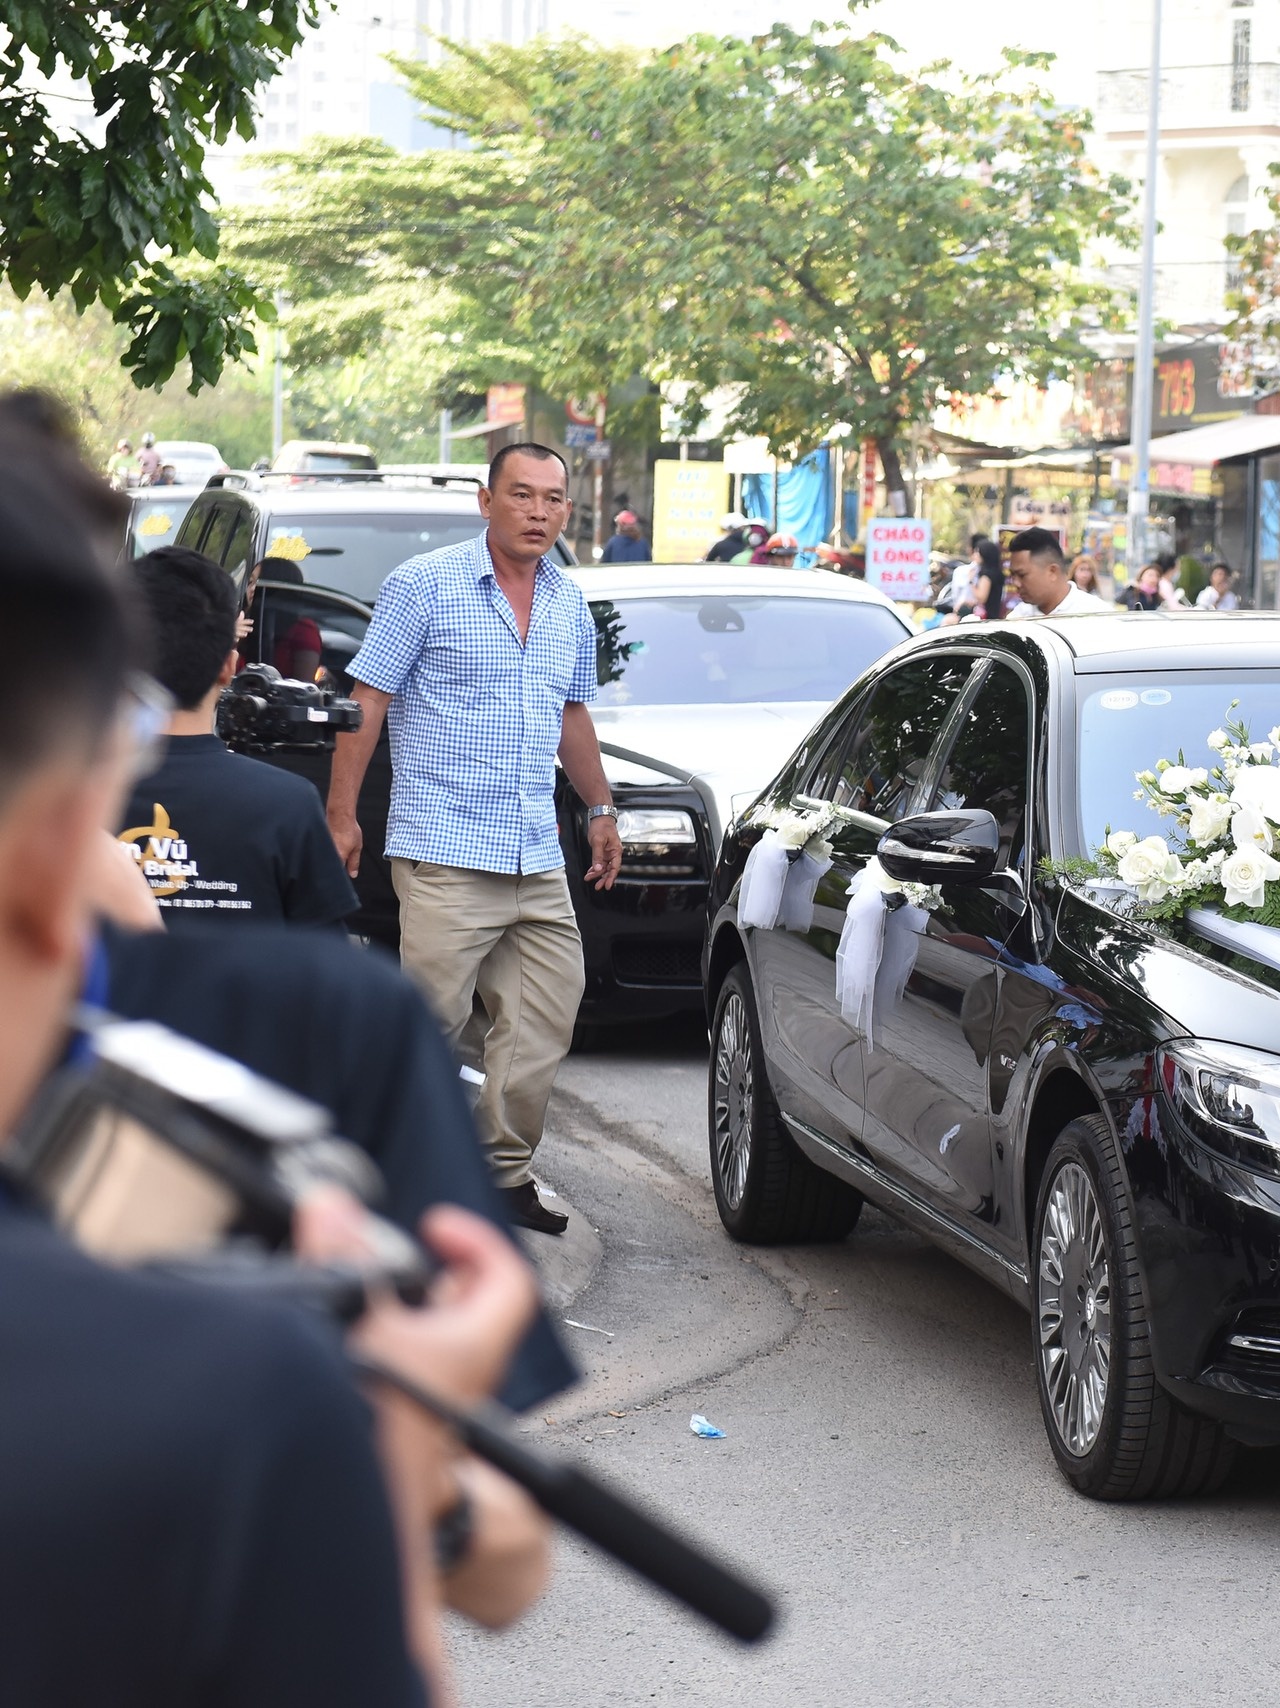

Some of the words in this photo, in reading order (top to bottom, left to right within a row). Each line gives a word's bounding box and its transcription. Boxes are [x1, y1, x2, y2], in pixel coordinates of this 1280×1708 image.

[873, 525, 924, 542] CHÁO
[144, 860, 198, 876] Bridal
[149, 879, 174, 889] Make
